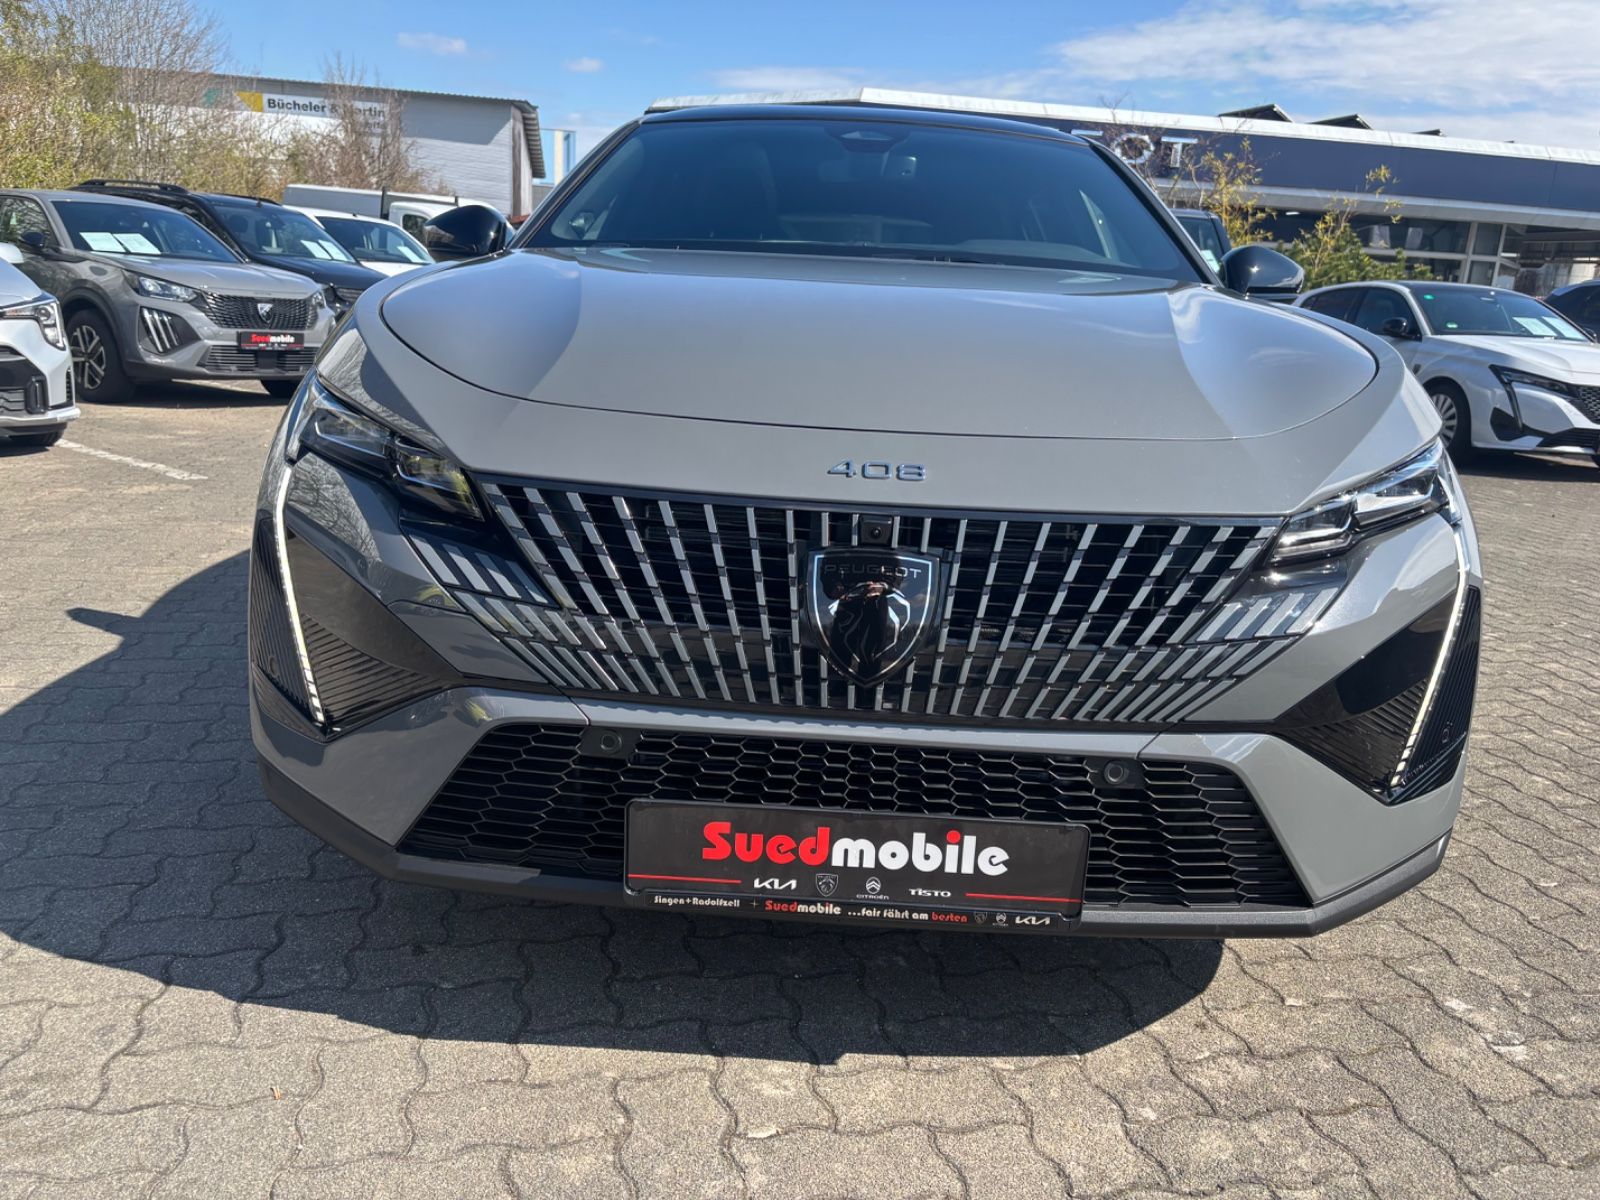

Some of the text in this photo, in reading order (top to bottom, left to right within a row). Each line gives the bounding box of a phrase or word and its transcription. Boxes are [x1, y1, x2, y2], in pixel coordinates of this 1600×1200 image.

[267, 98, 327, 114] Bücheler
[827, 459, 926, 481] 408
[824, 564, 922, 579] PEUGEOT
[702, 821, 1010, 876] Suedmobile
[753, 877, 798, 890] KIA
[764, 900, 842, 915] Suedmobile
[883, 908, 909, 919] fährt
[911, 913, 929, 921] am
[931, 911, 968, 923] besten
